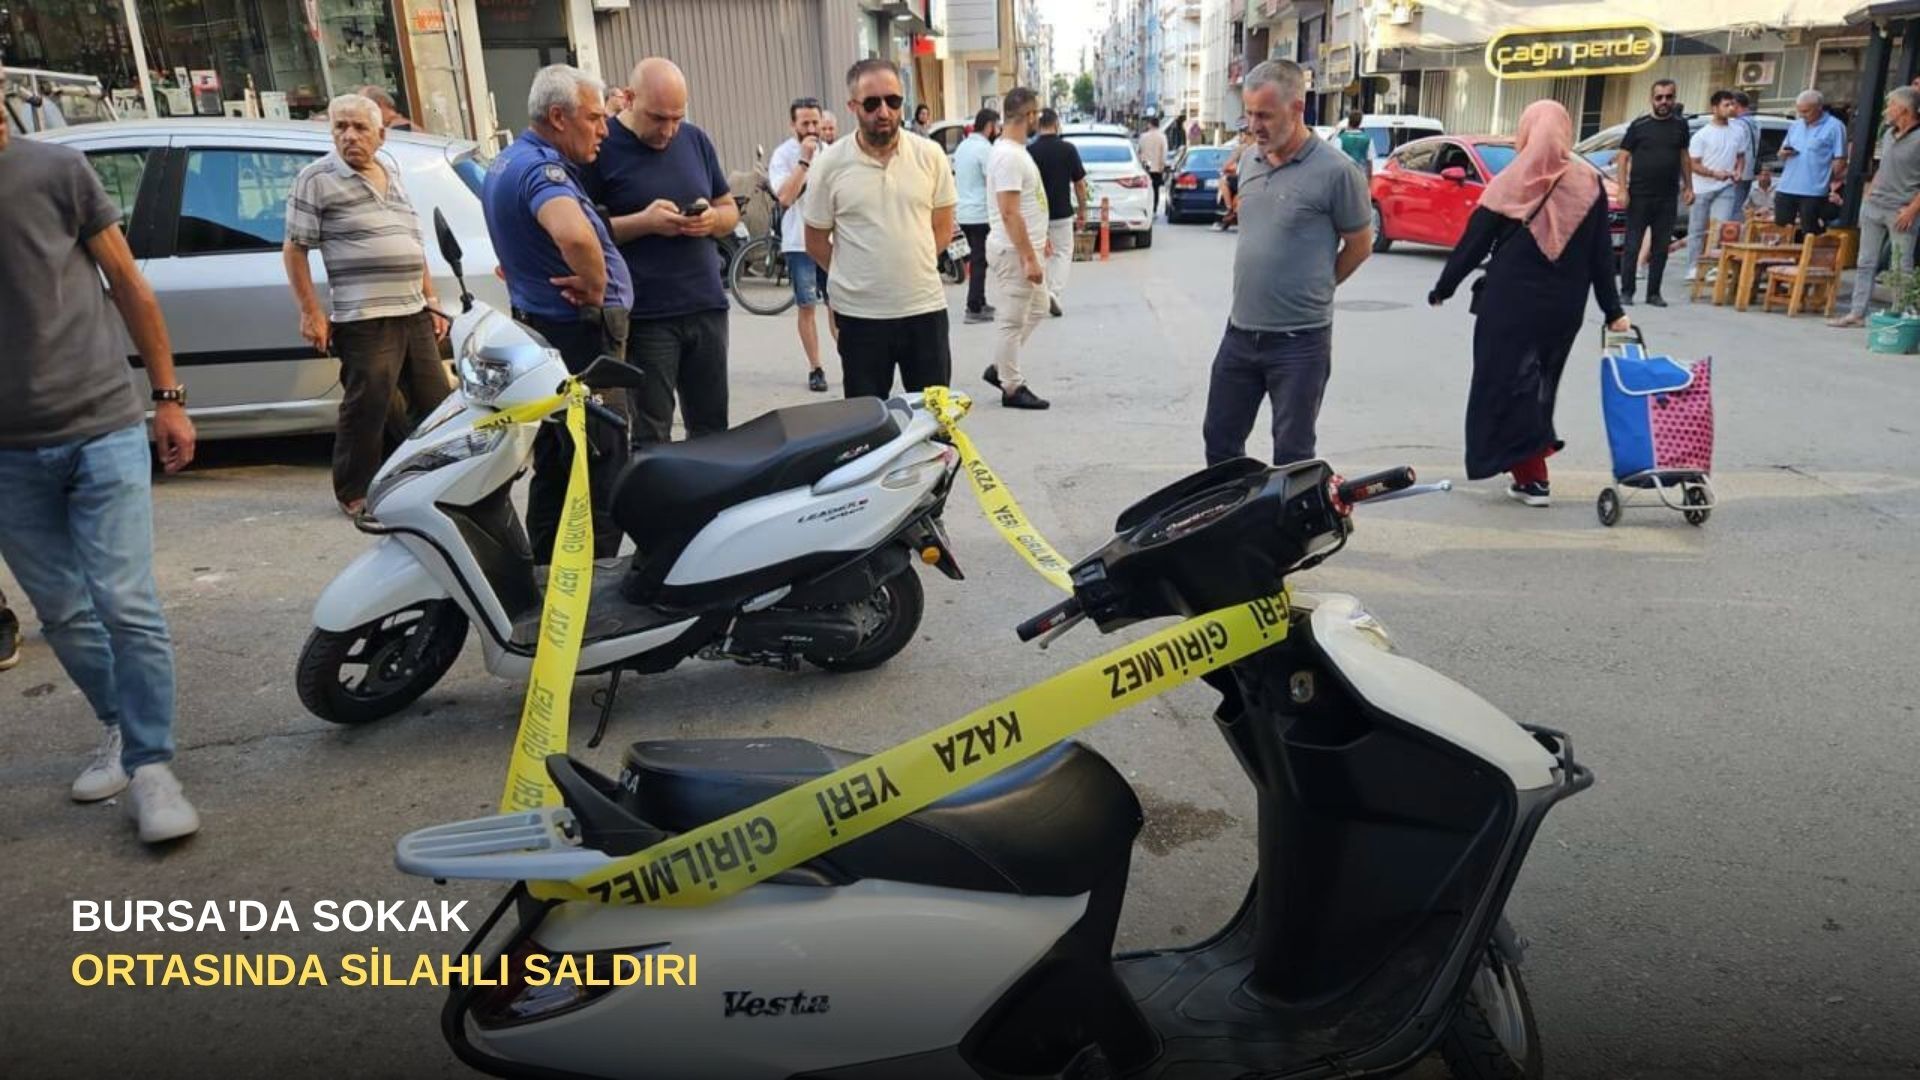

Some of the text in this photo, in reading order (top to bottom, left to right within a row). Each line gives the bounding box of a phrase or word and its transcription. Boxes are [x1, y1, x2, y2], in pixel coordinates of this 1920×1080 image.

[1570, 34, 1650, 64] perde
[968, 459, 996, 493] KAZA
[1103, 619, 1229, 698] GİRİLMEZ
[933, 711, 1023, 773] KAZA
[815, 767, 901, 838] YERİ
[722, 989, 831, 1018] Vesta
